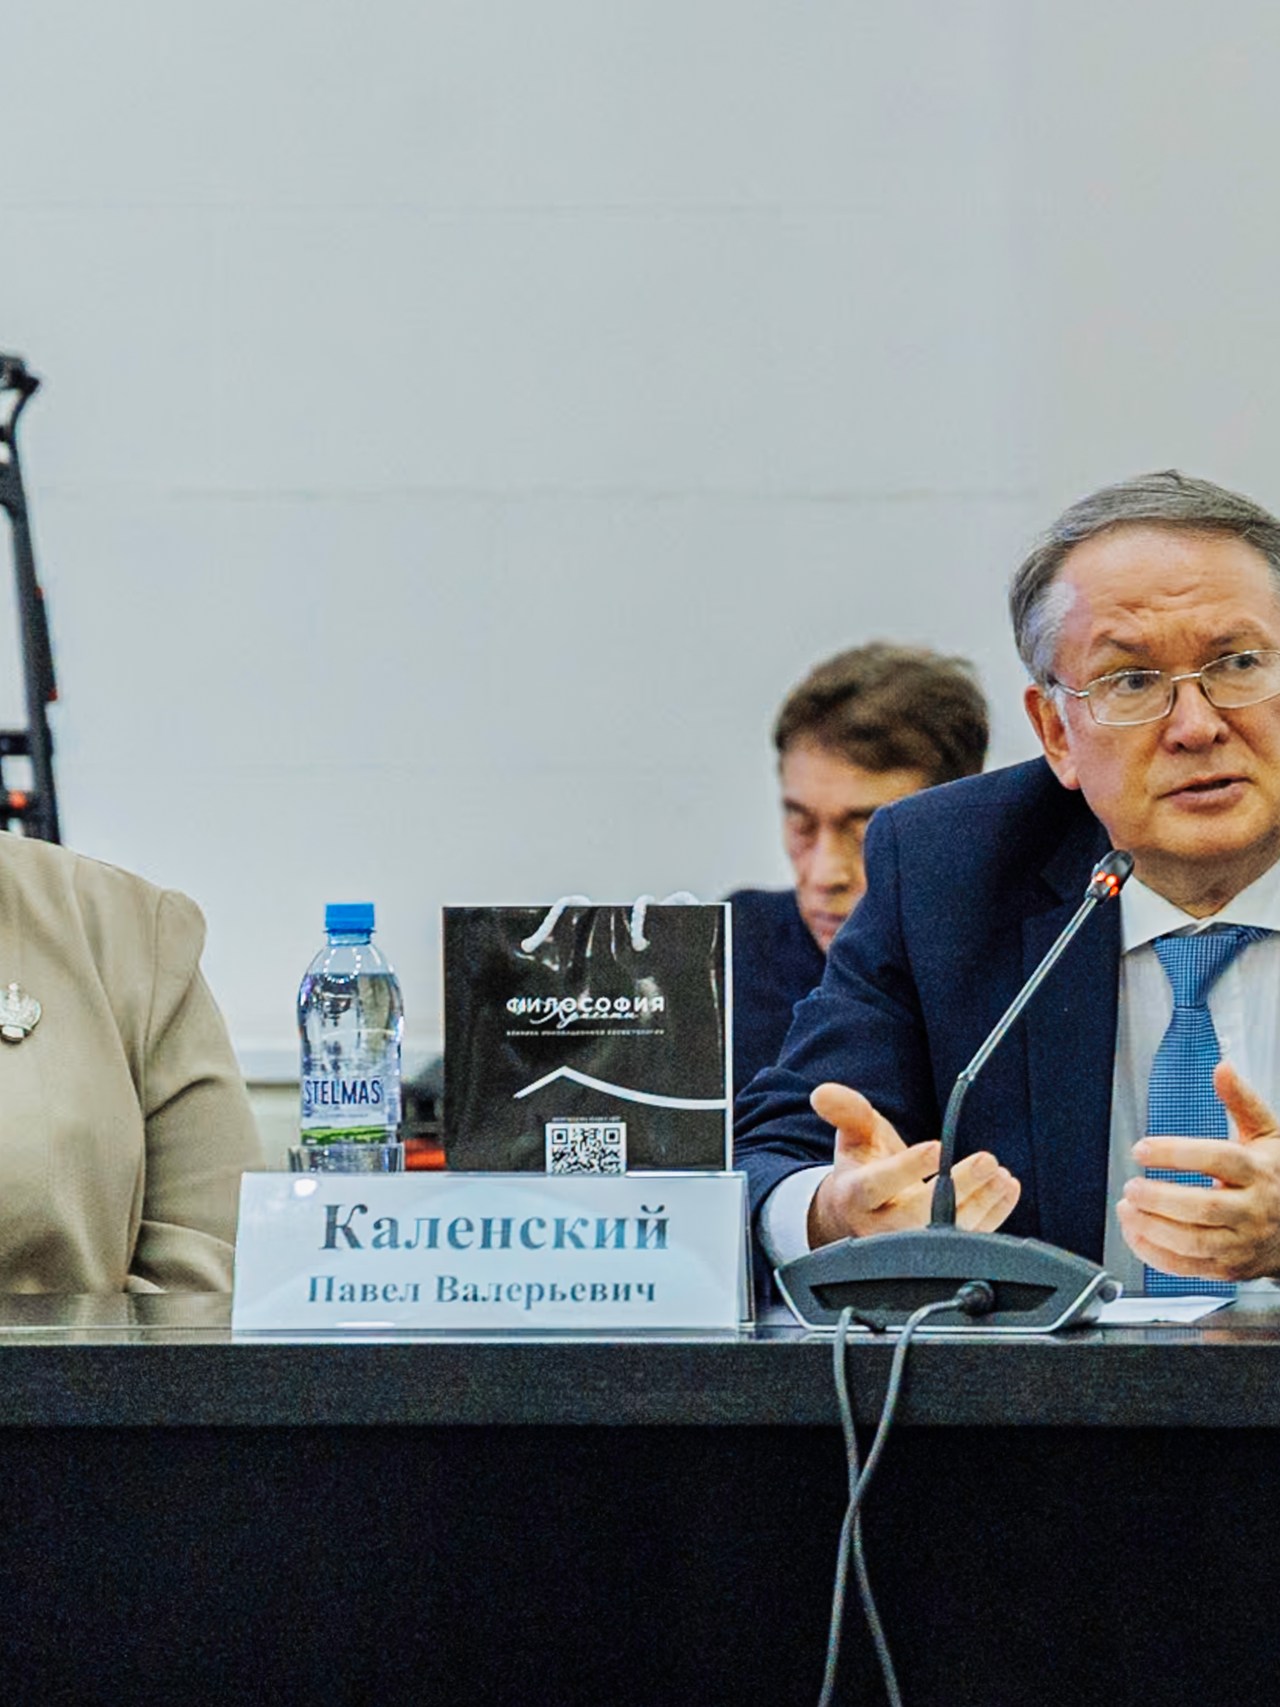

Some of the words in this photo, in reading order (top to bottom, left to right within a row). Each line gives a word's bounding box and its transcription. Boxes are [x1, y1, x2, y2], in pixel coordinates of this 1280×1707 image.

[506, 996, 664, 1013] ФИЛОСОФИЯ
[304, 1079, 381, 1104] STELMAS
[321, 1203, 670, 1251] Каленский
[307, 1275, 420, 1304] Павел
[435, 1275, 656, 1309] Валерьевич
